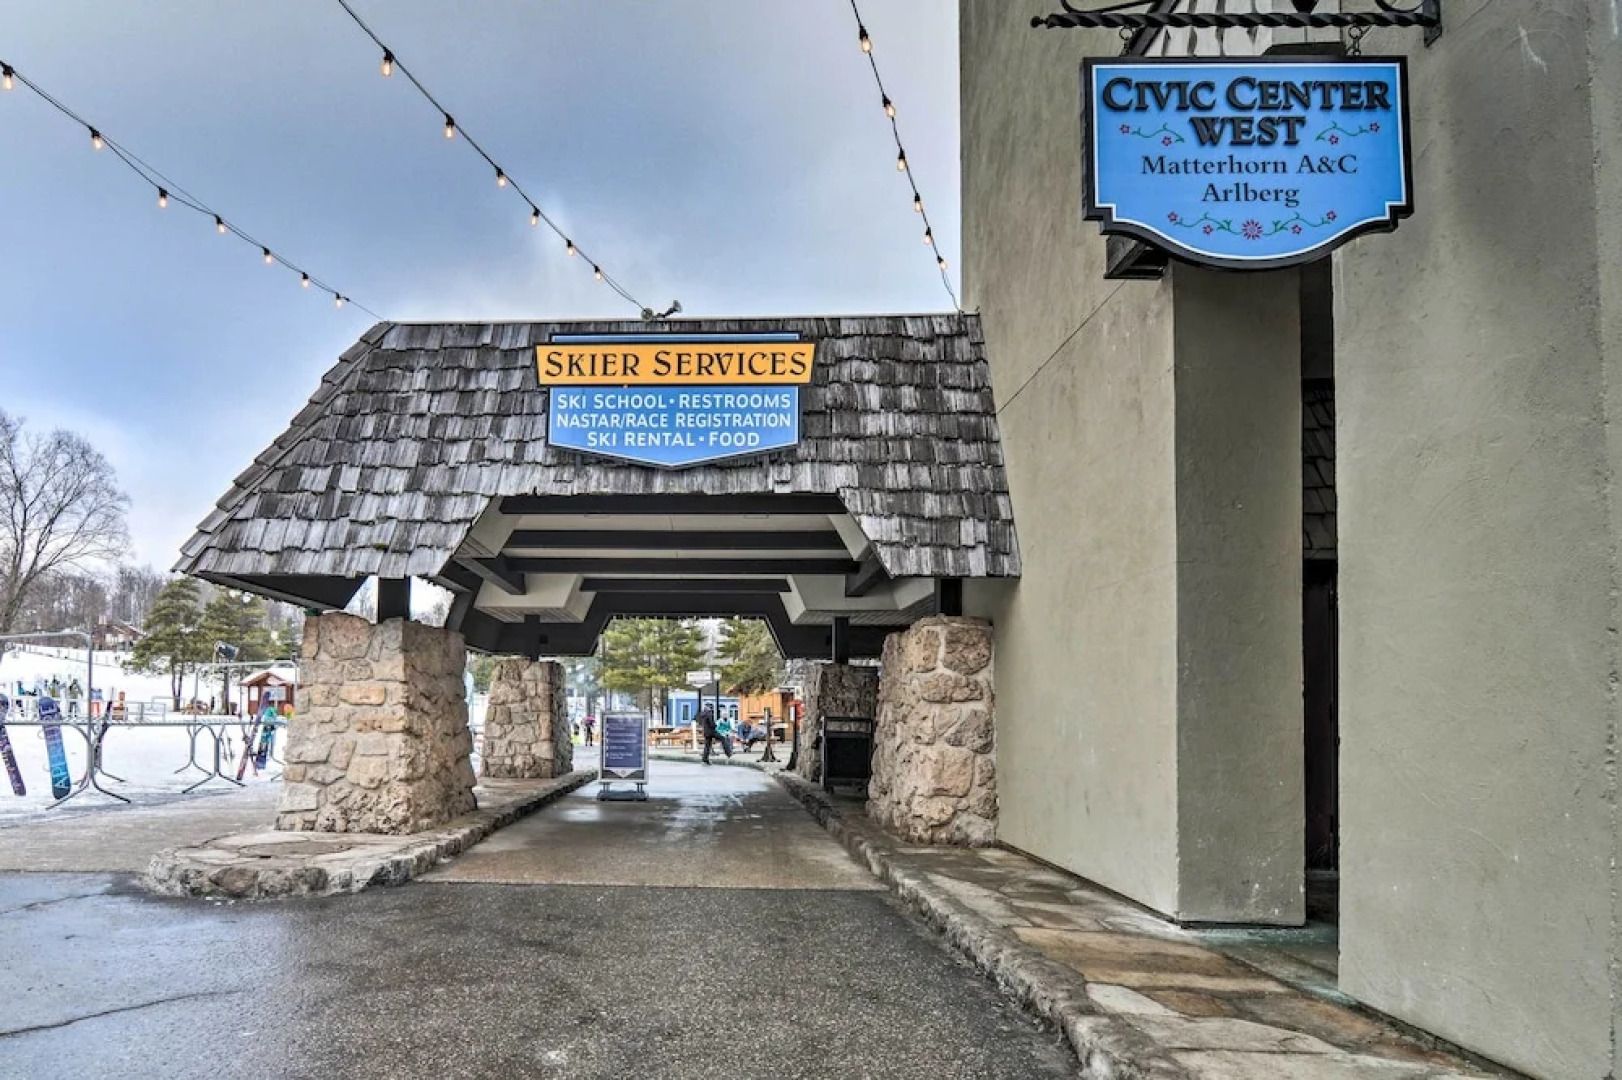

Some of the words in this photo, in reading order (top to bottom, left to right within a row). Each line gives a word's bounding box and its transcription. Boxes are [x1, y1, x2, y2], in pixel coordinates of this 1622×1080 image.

[1102, 76, 1216, 111] CIVIC
[1226, 76, 1391, 111] CENTER
[1188, 116, 1306, 147] WEST
[1141, 154, 1287, 175] Matterhorn
[1295, 154, 1357, 175] A&C
[1201, 182, 1301, 207] Arlberg
[544, 351, 640, 377] SKIER
[652, 350, 808, 377] SERVICES
[557, 394, 587, 410] SKI
[594, 394, 667, 410] SCHOOL
[679, 394, 791, 409] RESTROOMS
[557, 413, 668, 429] NASTAR/RACE
[675, 413, 791, 428] REGISTRATION
[587, 432, 617, 447] SKI
[624, 432, 696, 447] RENTAL
[709, 432, 760, 447] FOOD
